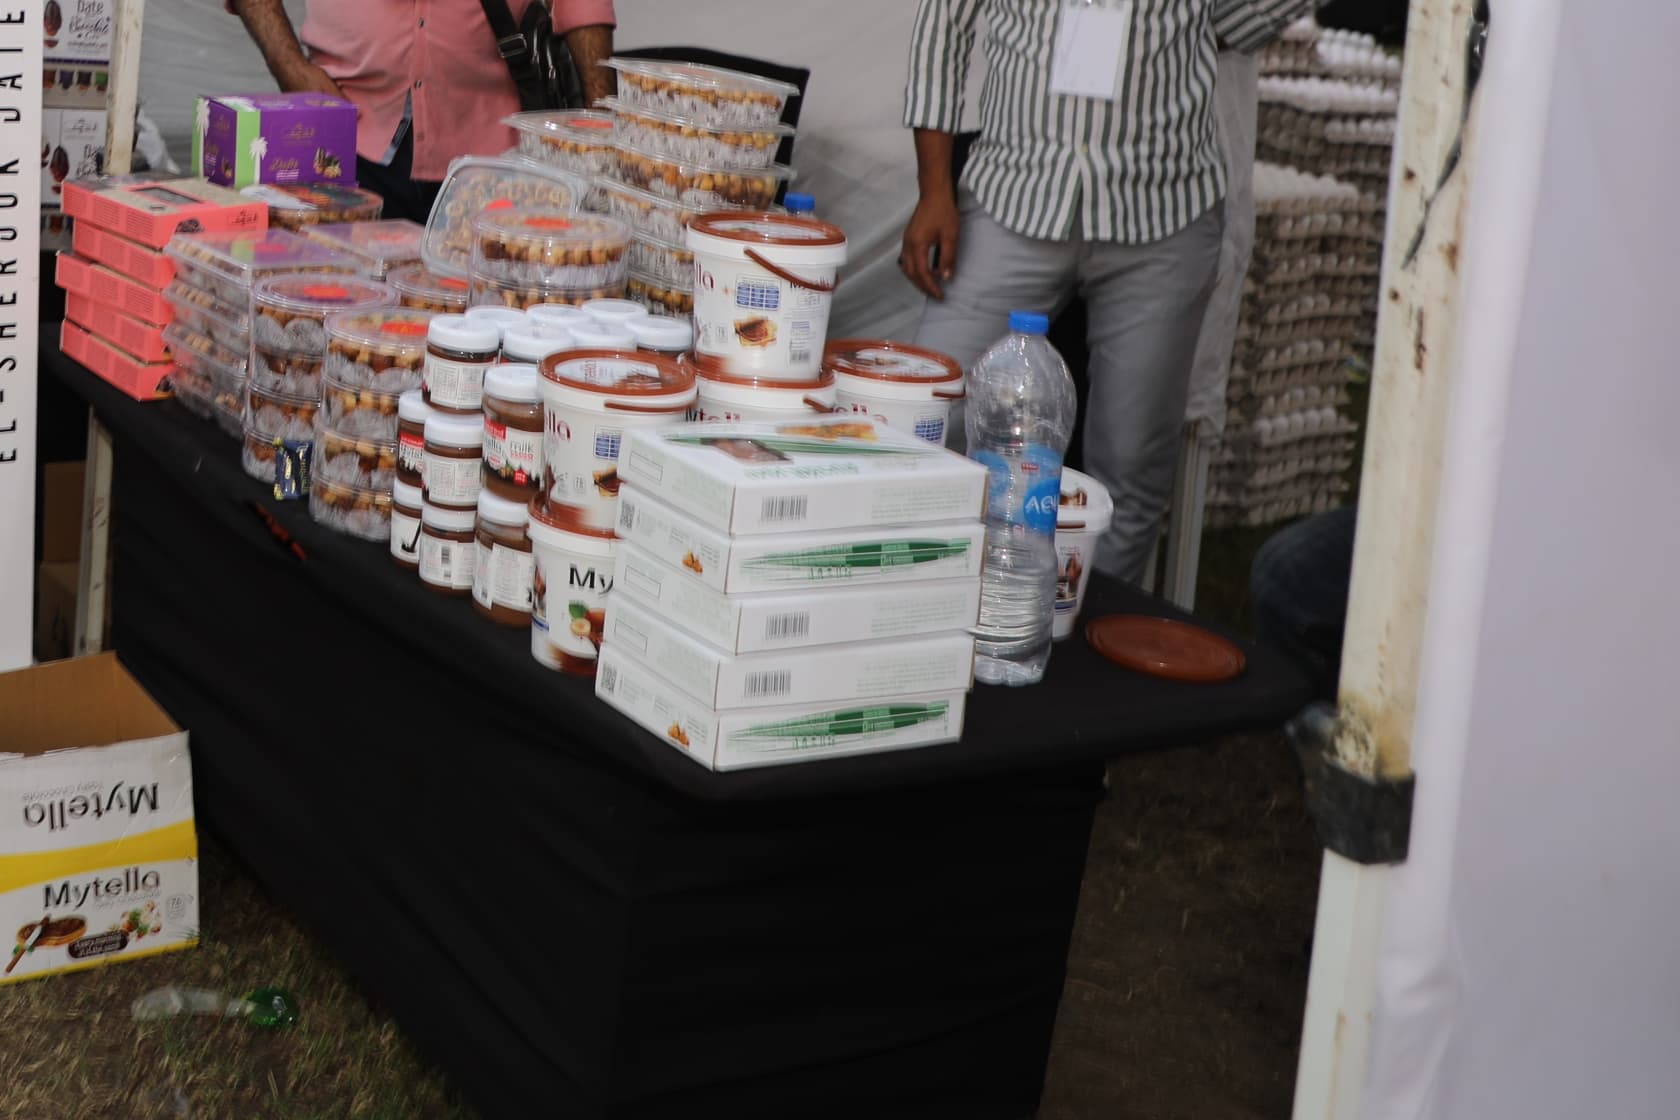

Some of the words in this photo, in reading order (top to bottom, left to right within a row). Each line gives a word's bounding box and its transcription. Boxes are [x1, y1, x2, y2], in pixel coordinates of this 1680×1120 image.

[569, 565, 614, 596] My
[23, 781, 159, 833] Mytella
[43, 867, 160, 910] Mytella
